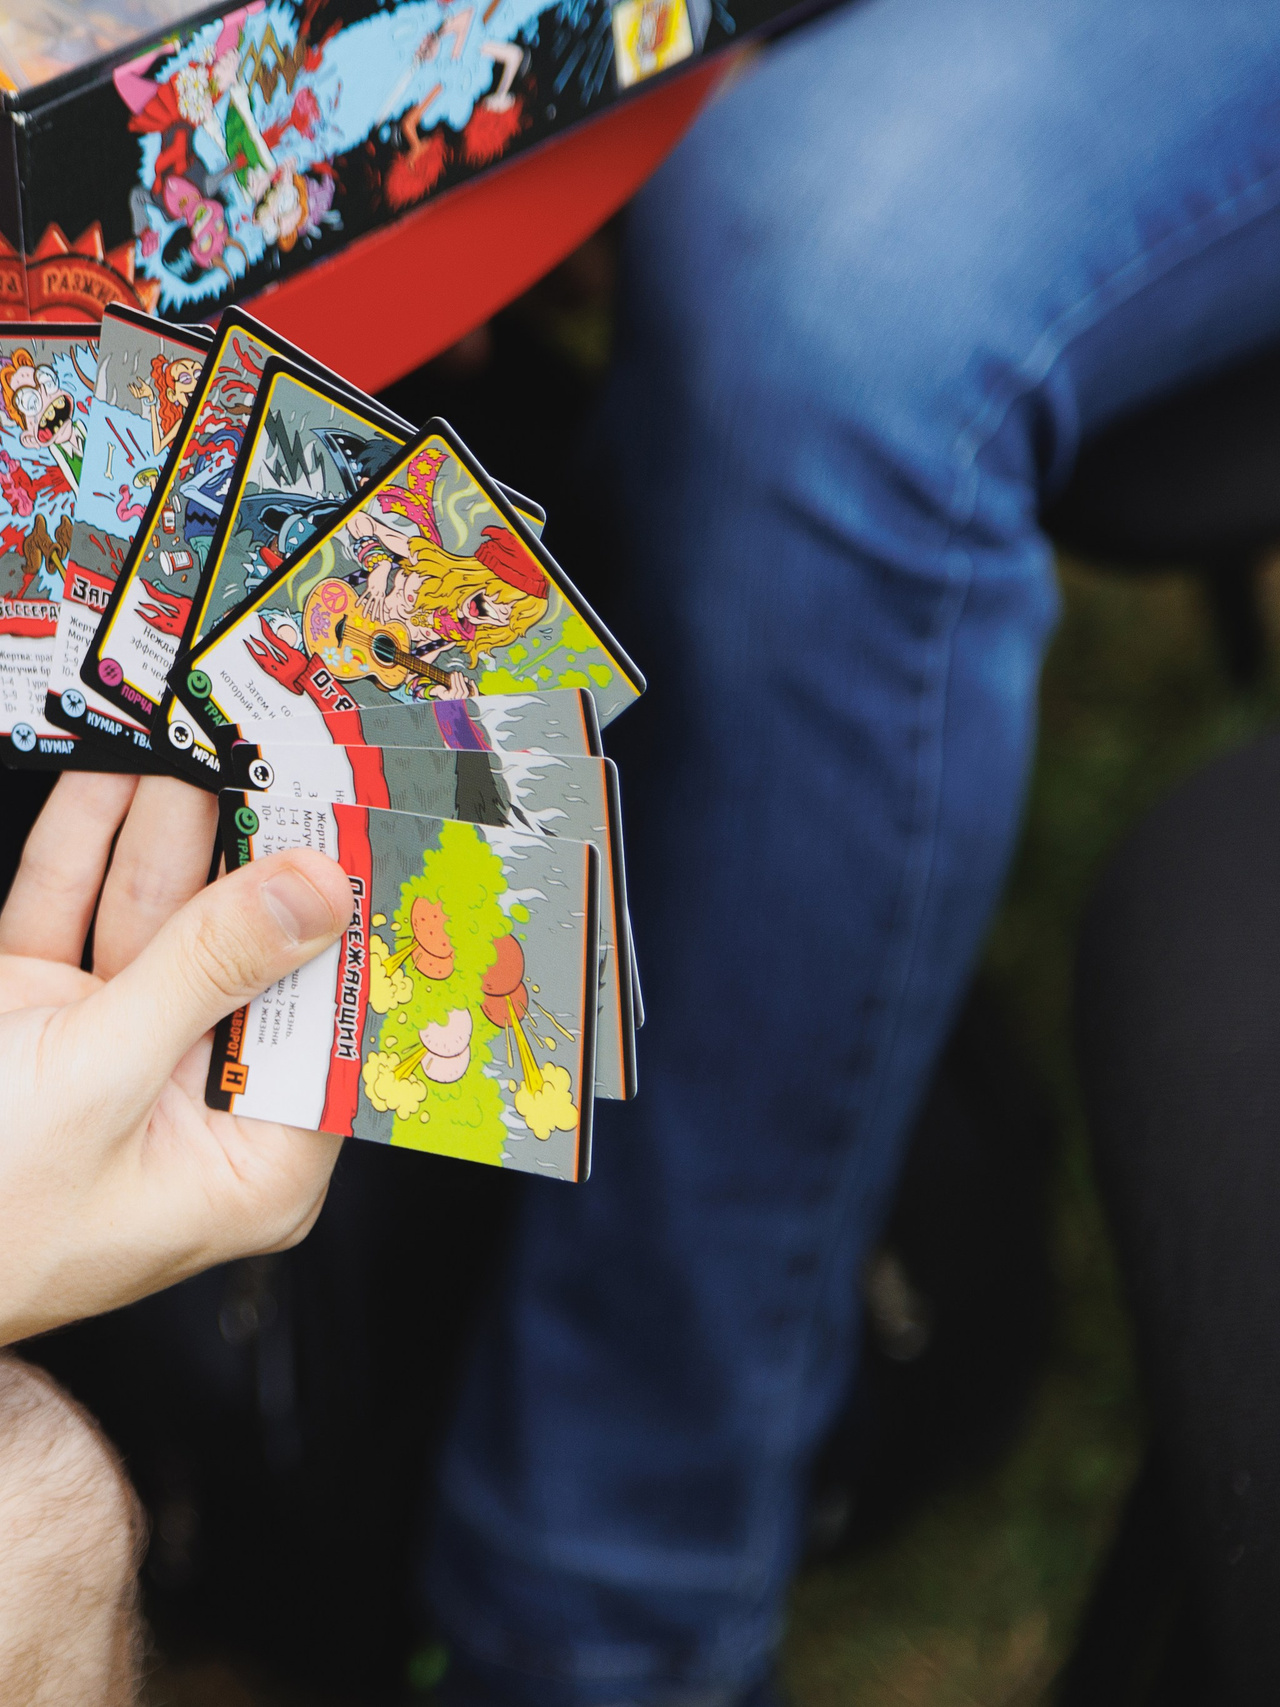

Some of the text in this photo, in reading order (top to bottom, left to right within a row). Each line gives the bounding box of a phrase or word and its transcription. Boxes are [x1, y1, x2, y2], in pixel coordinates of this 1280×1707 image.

[121, 684, 153, 715] ПОРЧА
[219, 670, 253, 712] который
[86, 711, 123, 737] КУМАР
[38, 739, 75, 754] КУМАР
